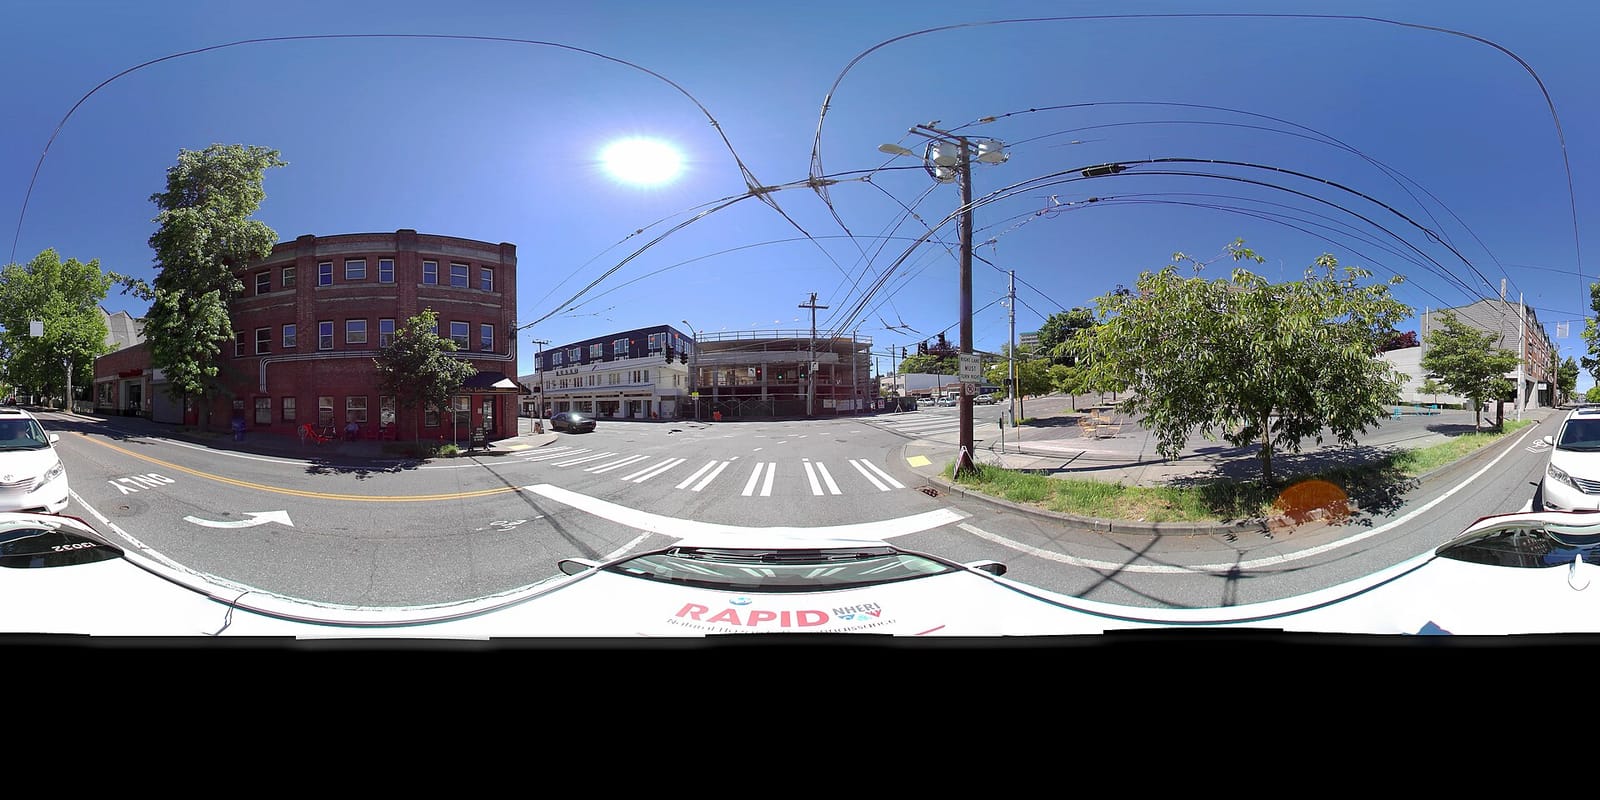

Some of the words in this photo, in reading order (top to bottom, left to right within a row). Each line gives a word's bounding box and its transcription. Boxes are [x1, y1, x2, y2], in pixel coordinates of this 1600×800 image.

[107, 472, 176, 495] ONLY
[674, 602, 830, 628] RAPID
[833, 602, 881, 616] NHERI
